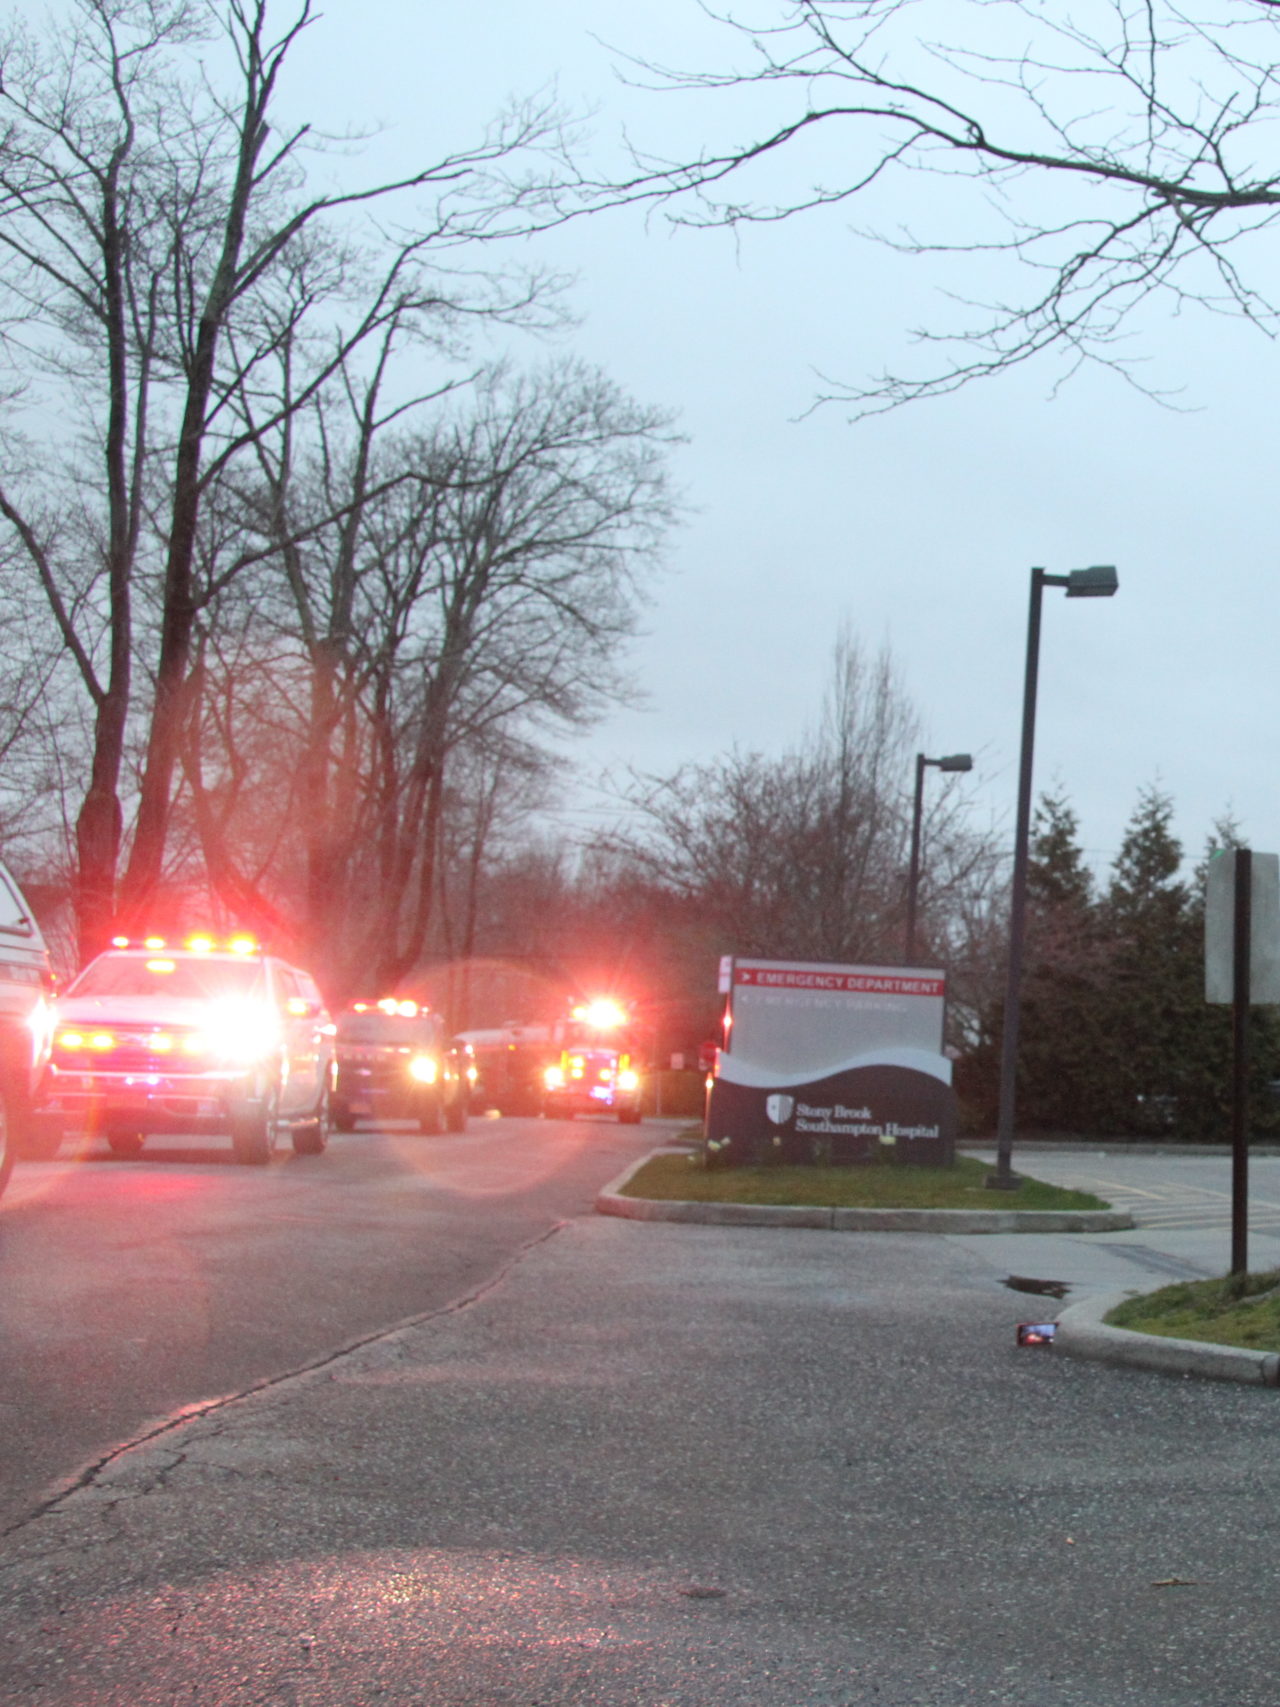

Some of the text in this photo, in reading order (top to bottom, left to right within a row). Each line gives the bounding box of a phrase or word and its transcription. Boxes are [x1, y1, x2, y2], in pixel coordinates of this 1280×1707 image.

[757, 973, 939, 993] EMERGENCY DEPARTMENT
[796, 1104, 872, 1119] Stony Brook
[795, 1119, 939, 1139] Southampton Hospital
